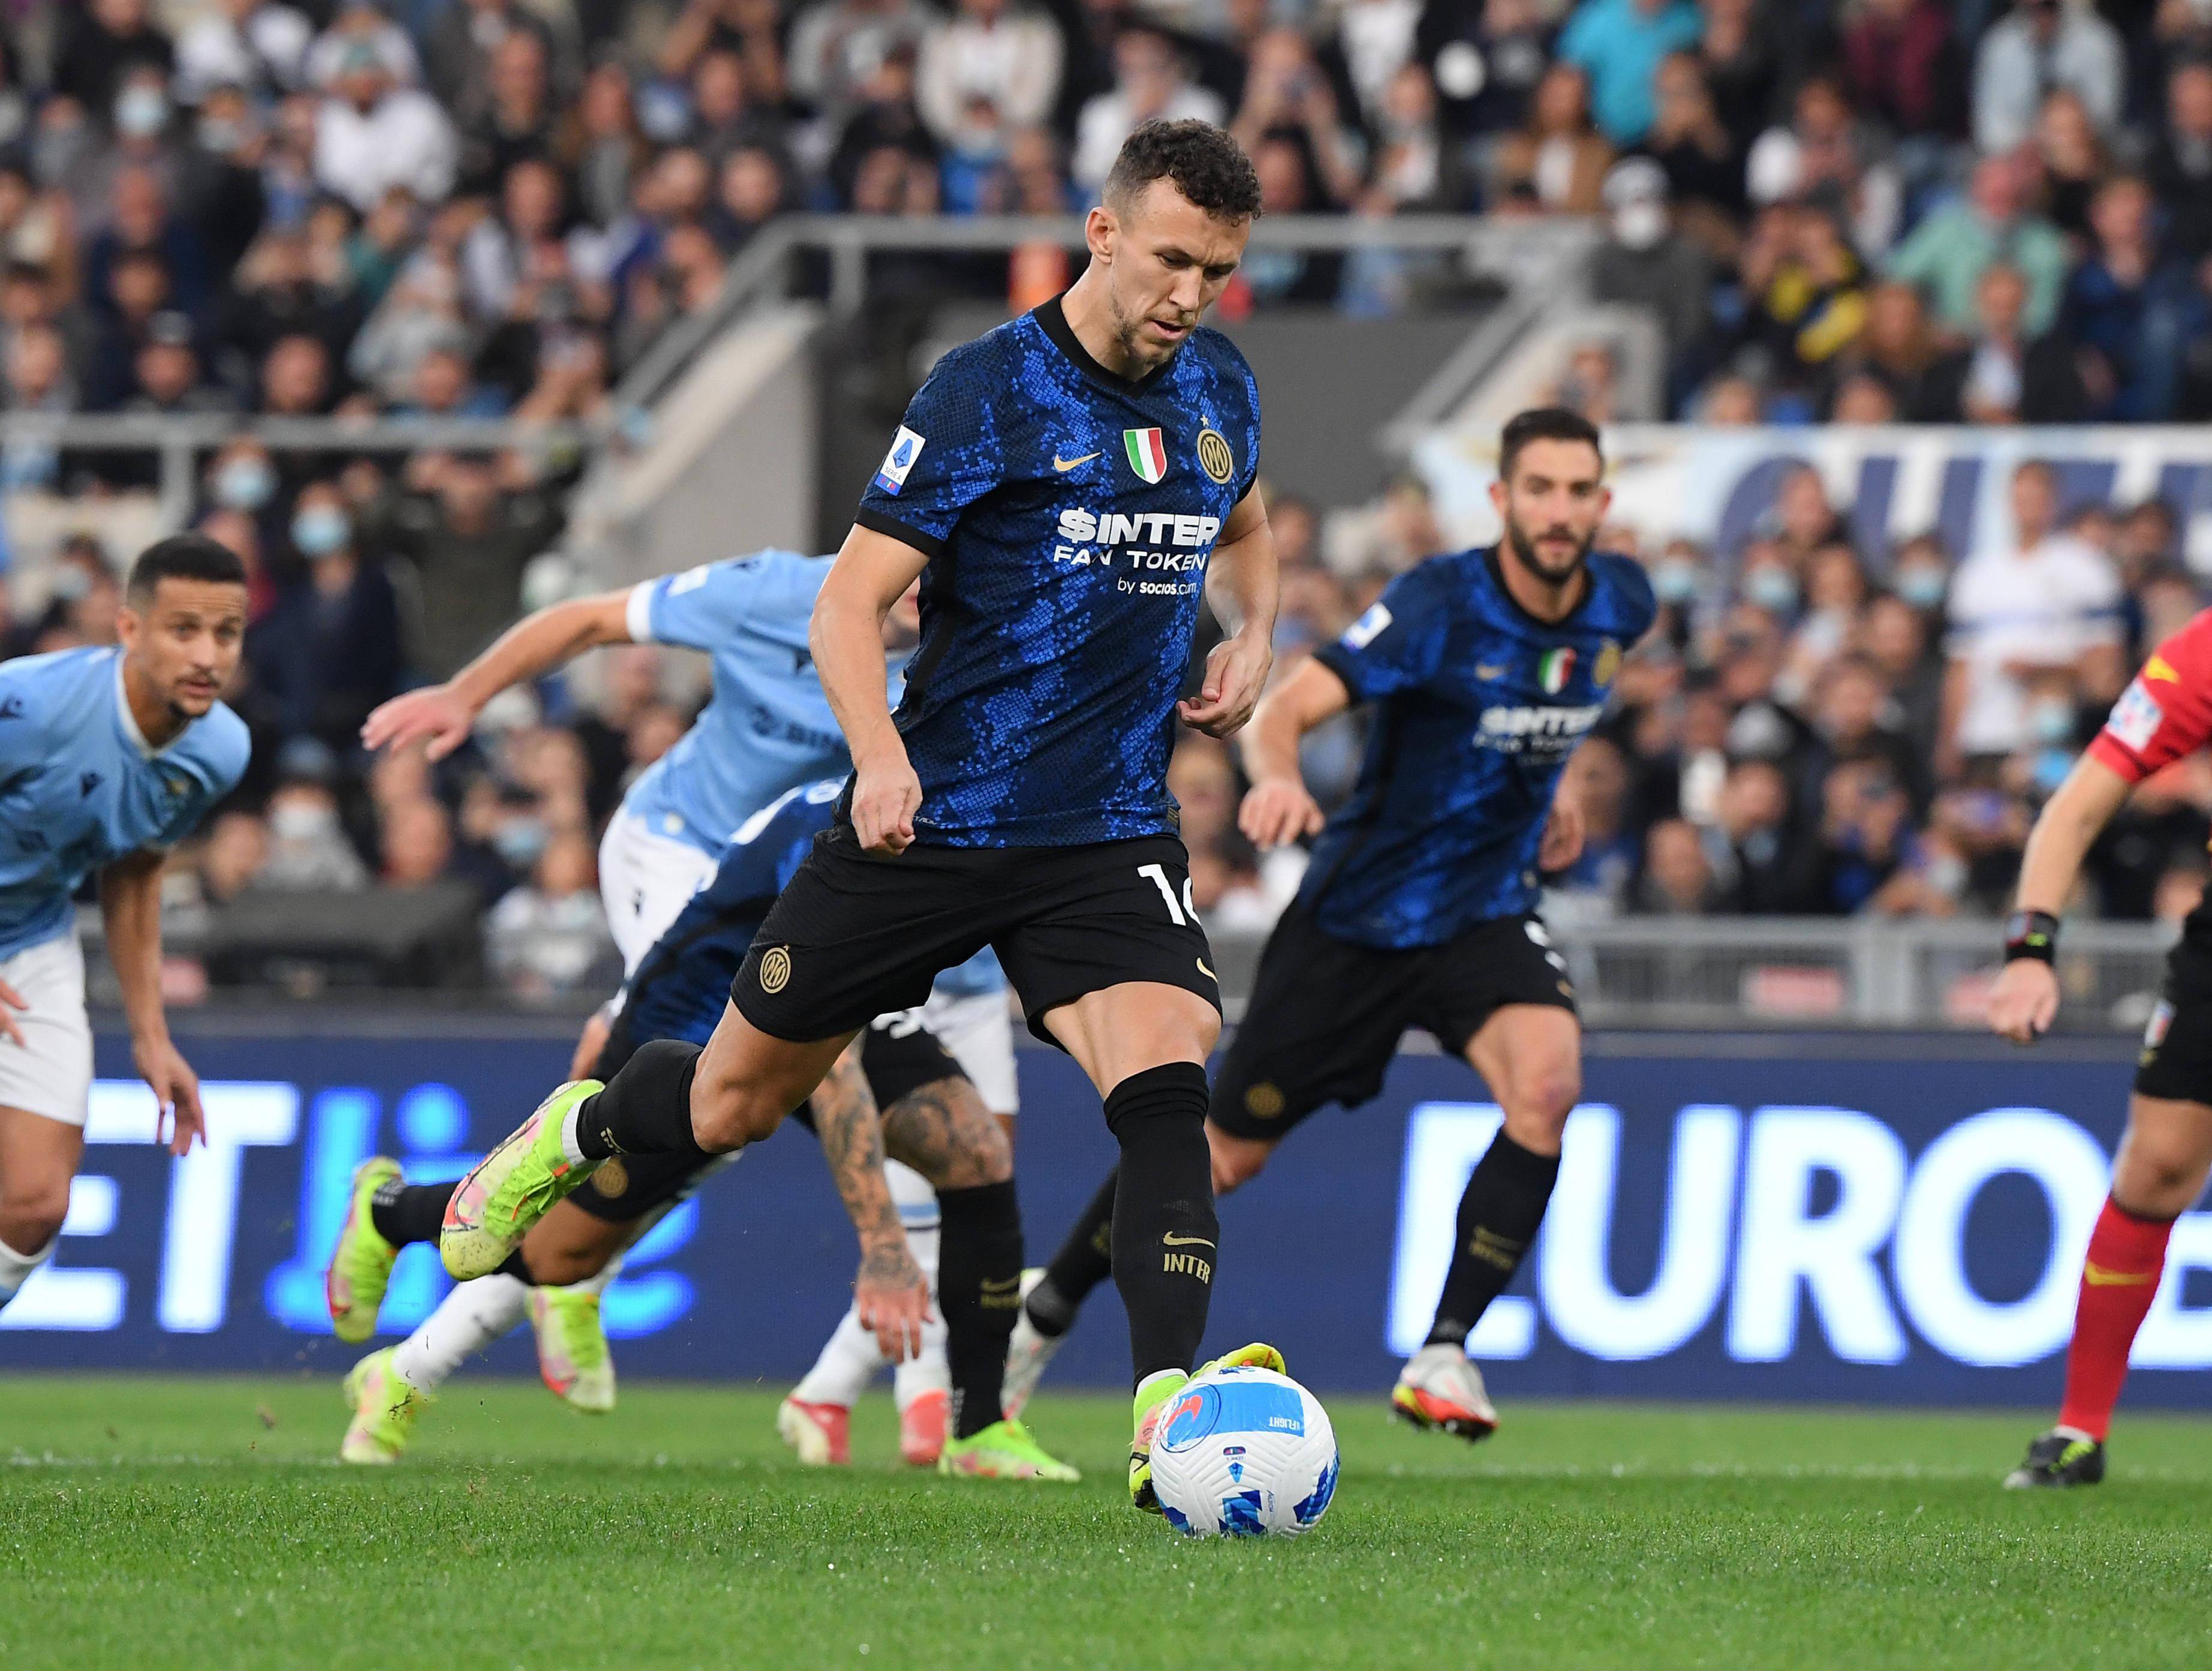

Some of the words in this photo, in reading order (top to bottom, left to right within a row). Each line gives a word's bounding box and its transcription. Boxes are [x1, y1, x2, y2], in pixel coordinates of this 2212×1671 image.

[884, 467, 898, 478] SERIE
[1057, 507, 1220, 546] $INTER
[1053, 545, 1113, 566] FAN
[1127, 550, 1206, 572] TOKEN
[1117, 576, 1136, 595] by
[1163, 1253, 1211, 1285] INTER
